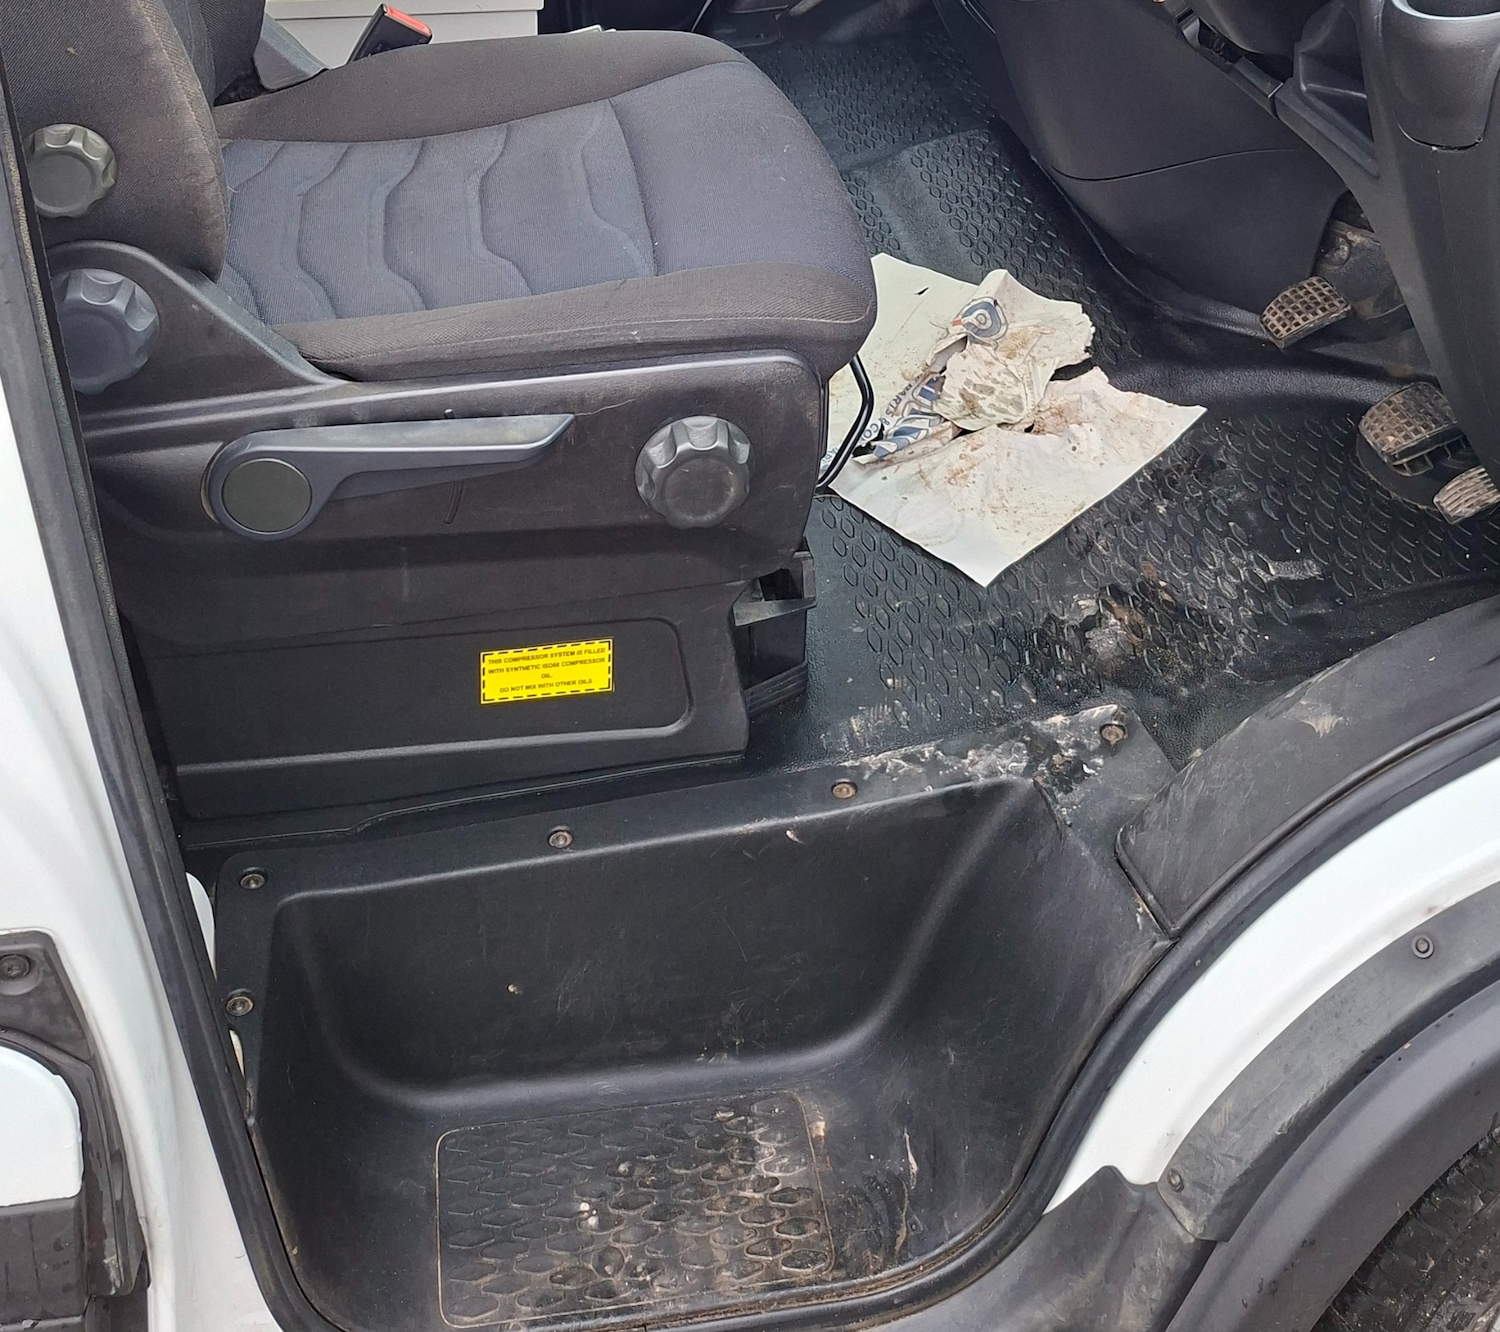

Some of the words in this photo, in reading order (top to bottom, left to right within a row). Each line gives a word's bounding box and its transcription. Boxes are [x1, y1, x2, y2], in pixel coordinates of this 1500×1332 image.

[885, 383, 913, 418] PARTS
[504, 654, 549, 663] COMPRESSOR
[550, 650, 575, 658] SYSTEM
[584, 647, 606, 655] FILLED
[506, 664, 541, 672] SYNTHETIC
[561, 657, 605, 667] COMPRESSOR
[555, 679, 577, 687] OTHER
